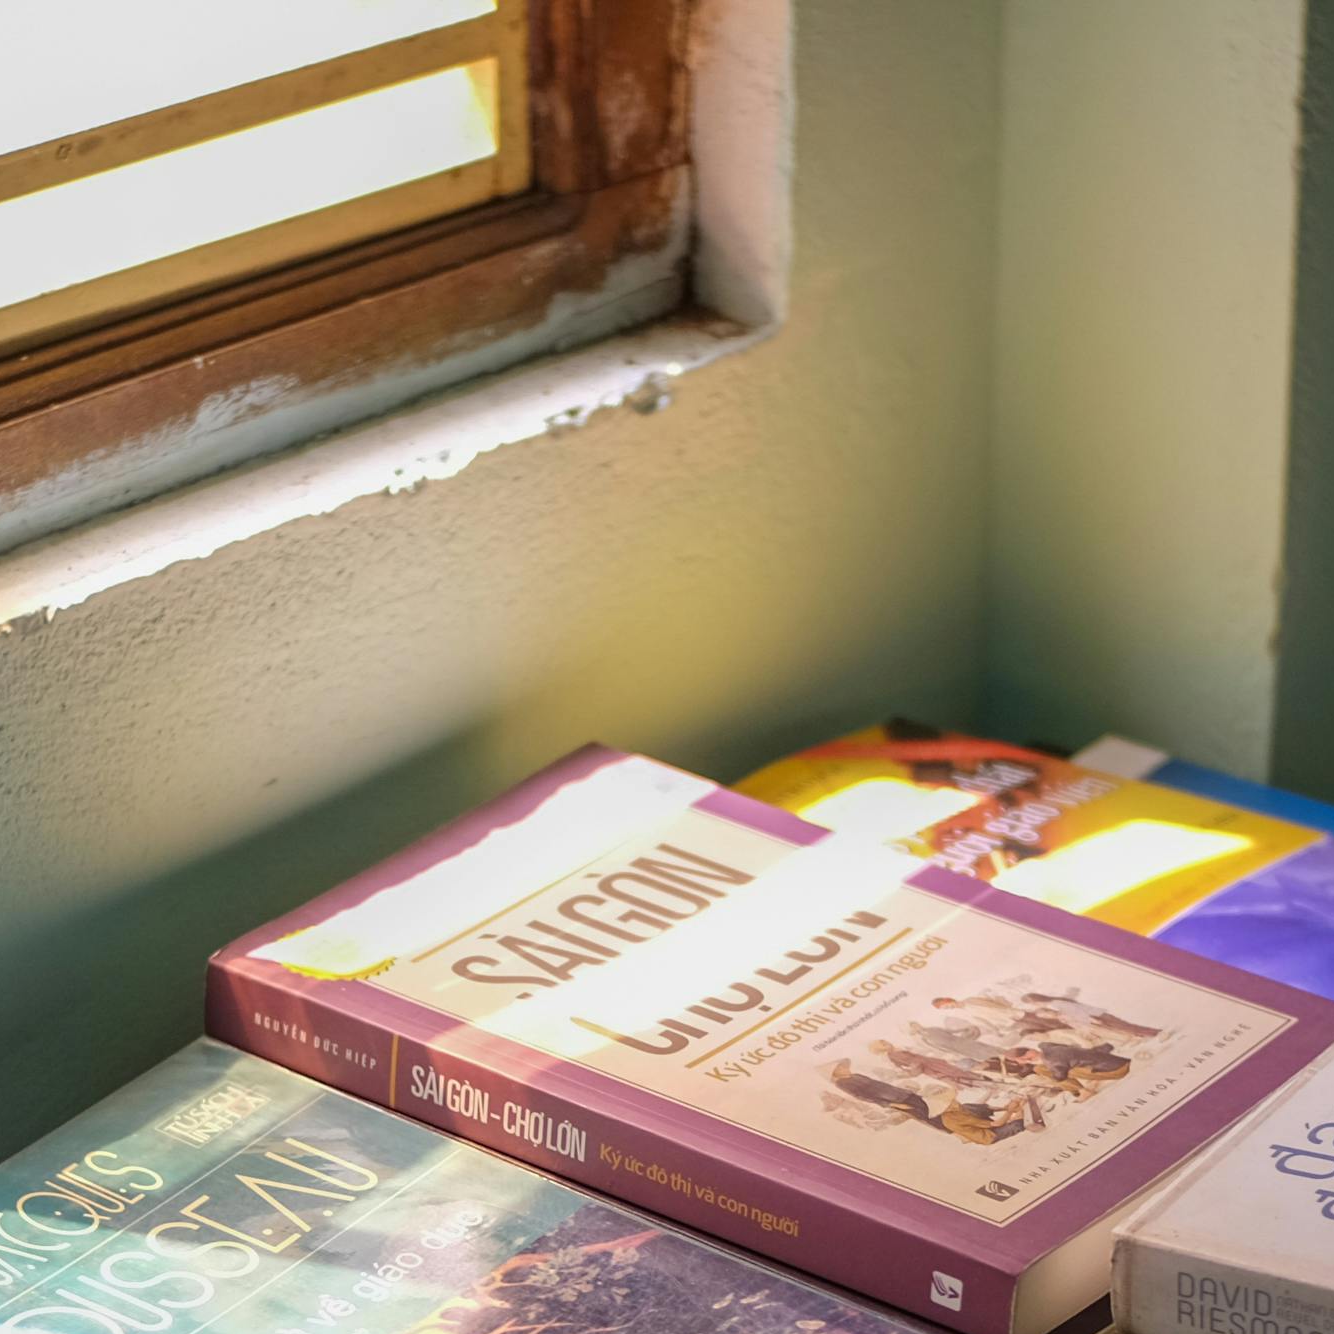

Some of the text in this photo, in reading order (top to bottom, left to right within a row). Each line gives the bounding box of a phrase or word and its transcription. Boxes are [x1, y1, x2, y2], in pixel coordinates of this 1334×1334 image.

[451, 919, 622, 999] SÀI
[558, 843, 756, 944] GÒN
[704, 1061, 753, 1083] Ký
[821, 994, 858, 1021] và
[850, 970, 894, 999] con
[886, 934, 949, 976] người
[411, 1064, 587, 1162] SÀI GÒN CHỢ LỚN
[599, 1143, 623, 1171] Ký
[624, 1154, 644, 1176] ức
[670, 1172, 692, 1198] thị
[694, 1184, 716, 1205] và
[718, 1195, 748, 1217] con
[750, 1208, 800, 1237] người
[352, 1250, 424, 1303] giáo
[1178, 1271, 1272, 1317] DAVID
